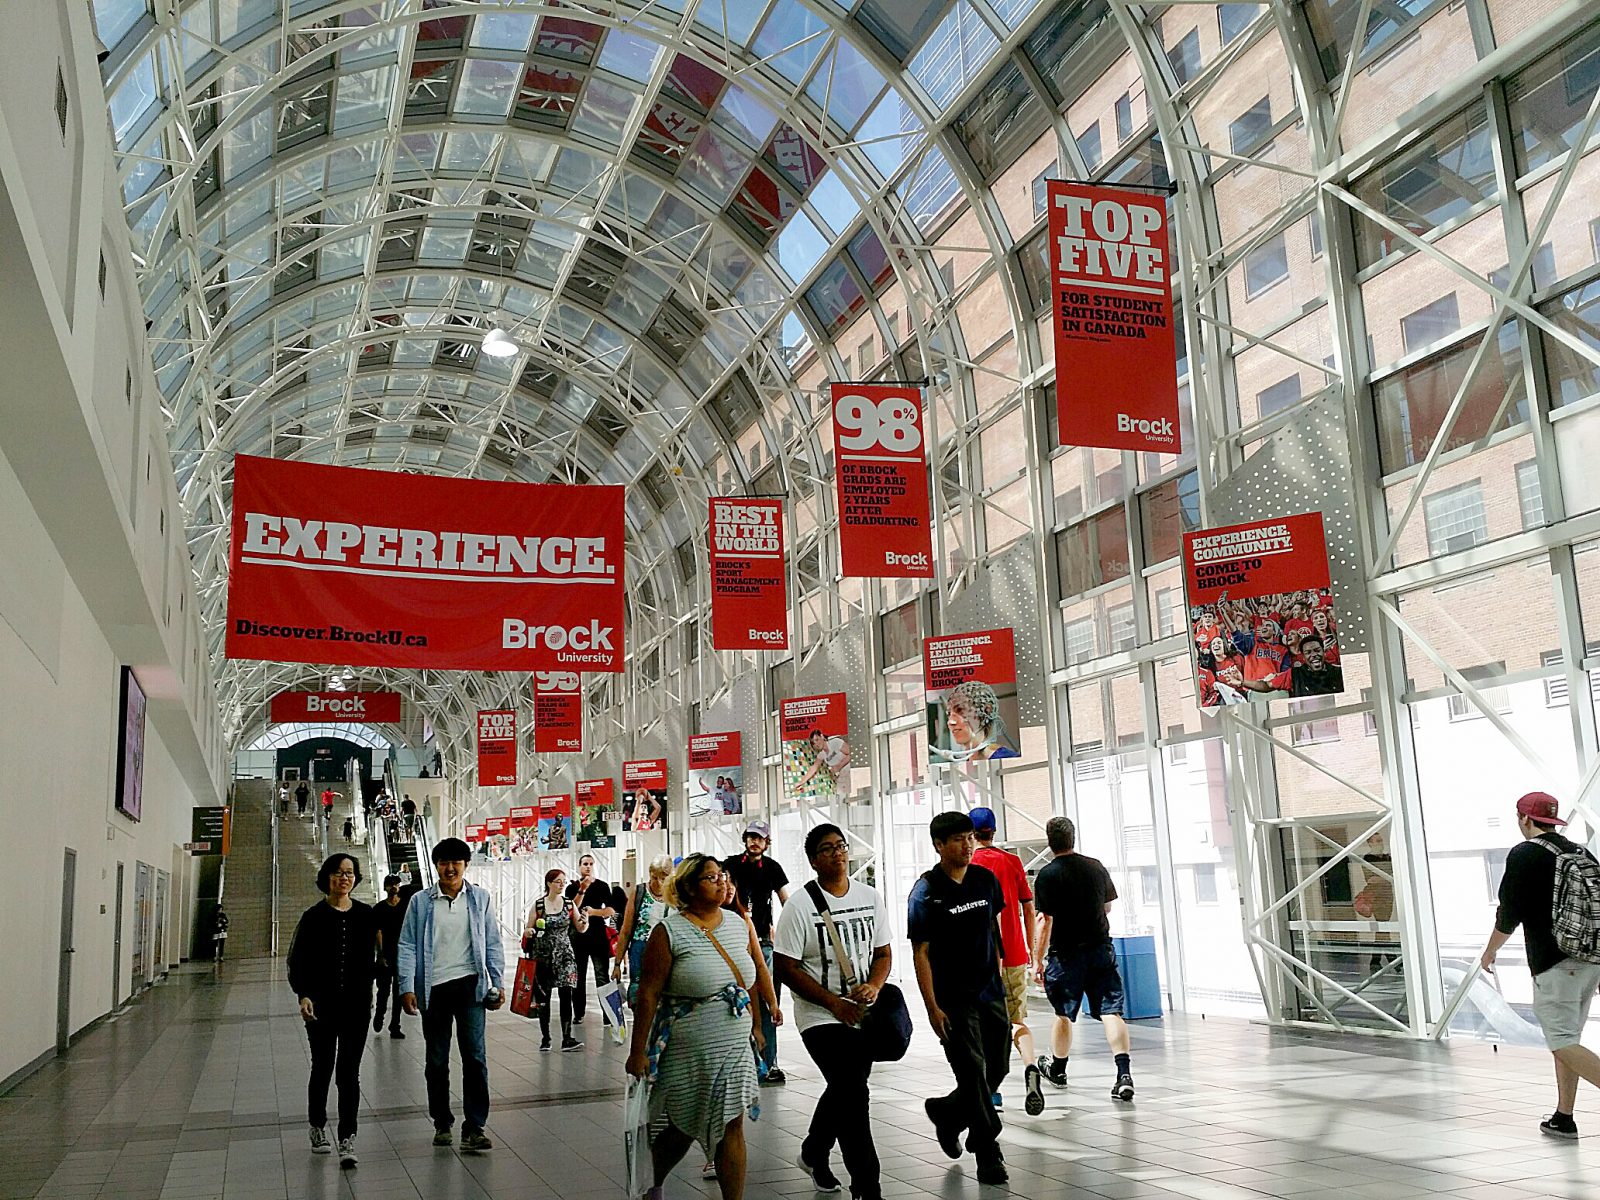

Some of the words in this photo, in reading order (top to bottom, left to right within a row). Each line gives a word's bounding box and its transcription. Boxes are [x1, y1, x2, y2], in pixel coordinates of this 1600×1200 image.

[1055, 194, 1162, 246] TOP
[1057, 236, 1164, 283] FIVE
[1061, 291, 1089, 305] FOR
[1093, 295, 1163, 313] STUDENT
[1061, 305, 1167, 327] SATISFACTION
[1062, 320, 1080, 331] IN
[1084, 321, 1147, 338] CANADA
[1117, 413, 1174, 436] Brock
[1145, 434, 1174, 444] University
[842, 464, 857, 474] OF
[859, 465, 897, 475] BROCK
[843, 475, 882, 485] GRADS
[884, 476, 906, 486] ARE
[843, 485, 906, 496] EMPLOYED
[844, 496, 851, 505] 2
[852, 496, 891, 505] YEARS
[714, 505, 778, 525] BEST
[845, 505, 882, 515] AFTER
[715, 523, 738, 537] IN
[740, 525, 778, 539] THE
[1192, 524, 1290, 550] EXPERIENCE.
[242, 512, 615, 574] EXPERIENCE.
[714, 537, 780, 551] WORLD
[1194, 535, 1293, 561] COMMUNITY.
[885, 551, 928, 565] Brock
[1195, 561, 1240, 577] COME
[1242, 558, 1262, 570] TO
[716, 577, 780, 586] MANAGEMENT
[236, 619, 428, 647] Discover.BrockU.ca
[503, 619, 614, 650] Brock
[749, 629, 784, 640] Brock
[929, 636, 992, 650] EXPERIENCE.
[557, 652, 613, 665] University
[930, 647, 973, 659] LEADING
[930, 654, 983, 667] RESEARCH.
[931, 669, 960, 679] COME
[962, 667, 974, 676] TO
[306, 696, 366, 711] Brock
[480, 714, 514, 727] TOP
[785, 717, 808, 725] COME
[480, 726, 514, 738] FIVE
[557, 739, 580, 747] Brock
[949, 899, 988, 914] whatever.
